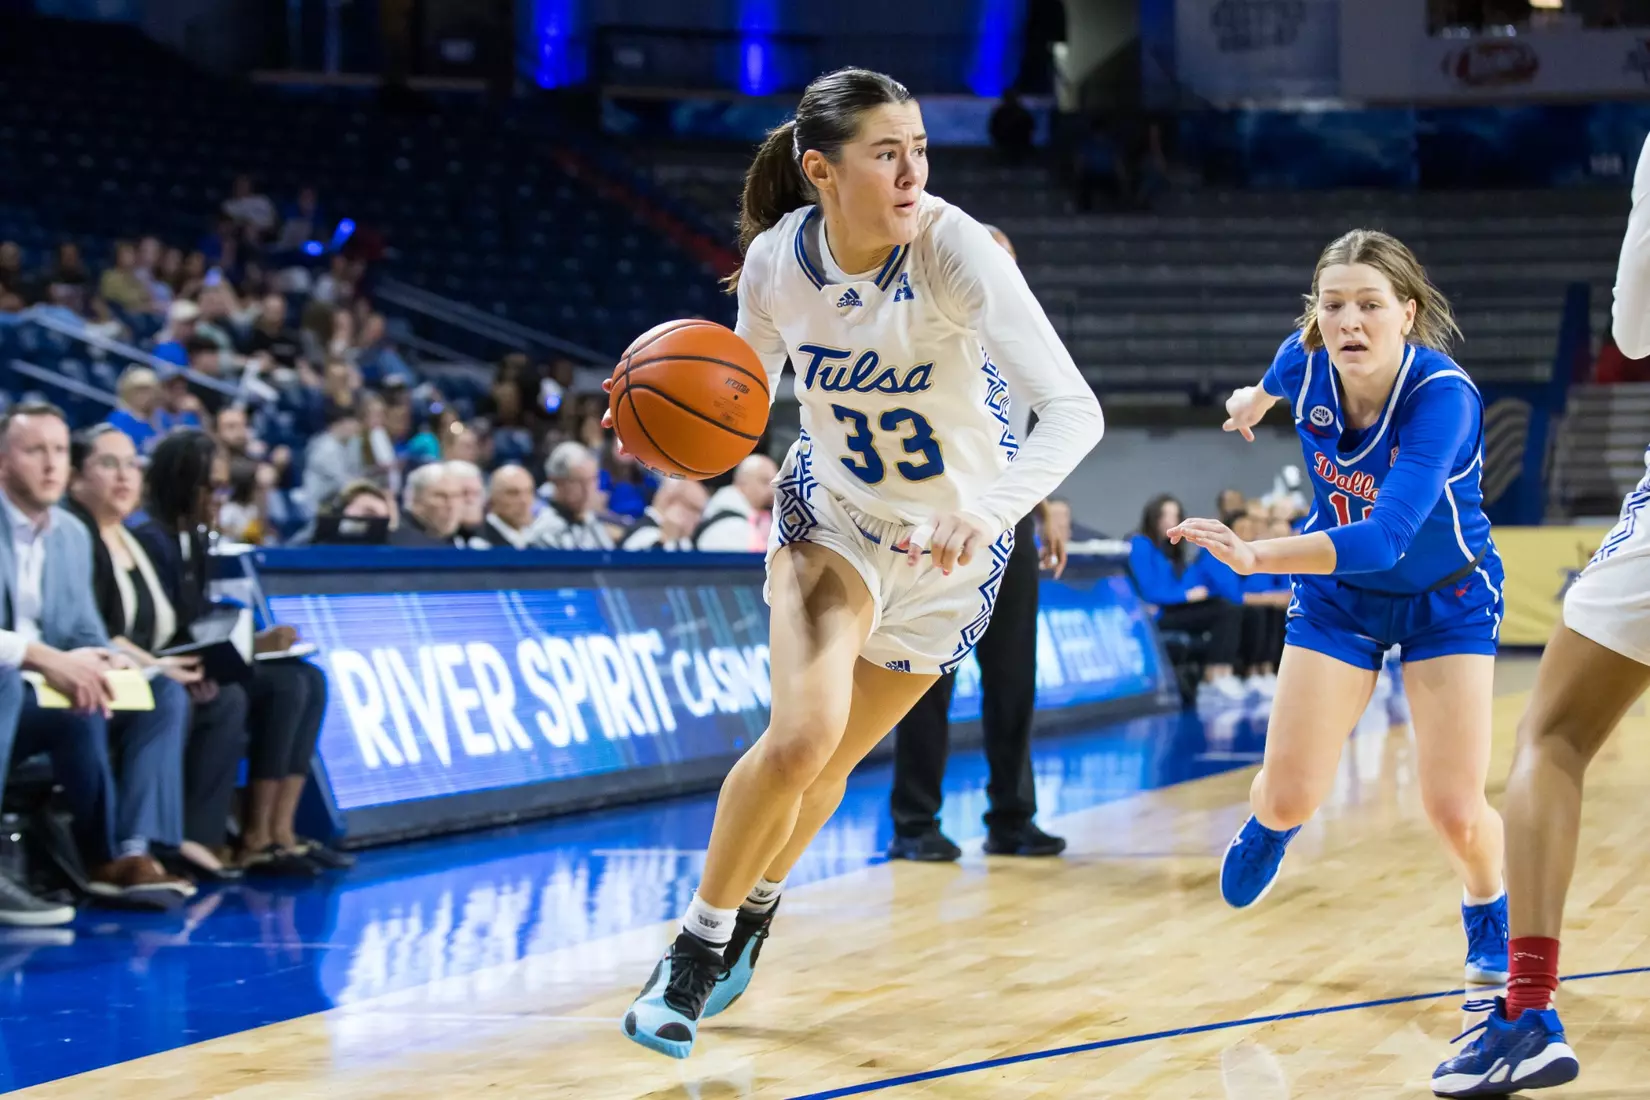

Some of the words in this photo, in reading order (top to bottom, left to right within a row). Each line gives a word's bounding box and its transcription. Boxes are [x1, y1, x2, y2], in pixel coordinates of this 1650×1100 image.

[837, 299, 862, 308] adidas
[797, 343, 936, 395] Tulsa
[828, 402, 945, 485] 33
[1313, 450, 1380, 503] Dalla
[1328, 490, 1375, 527] 1
[329, 640, 533, 769] RIVER
[516, 627, 677, 749] SPIRIT
